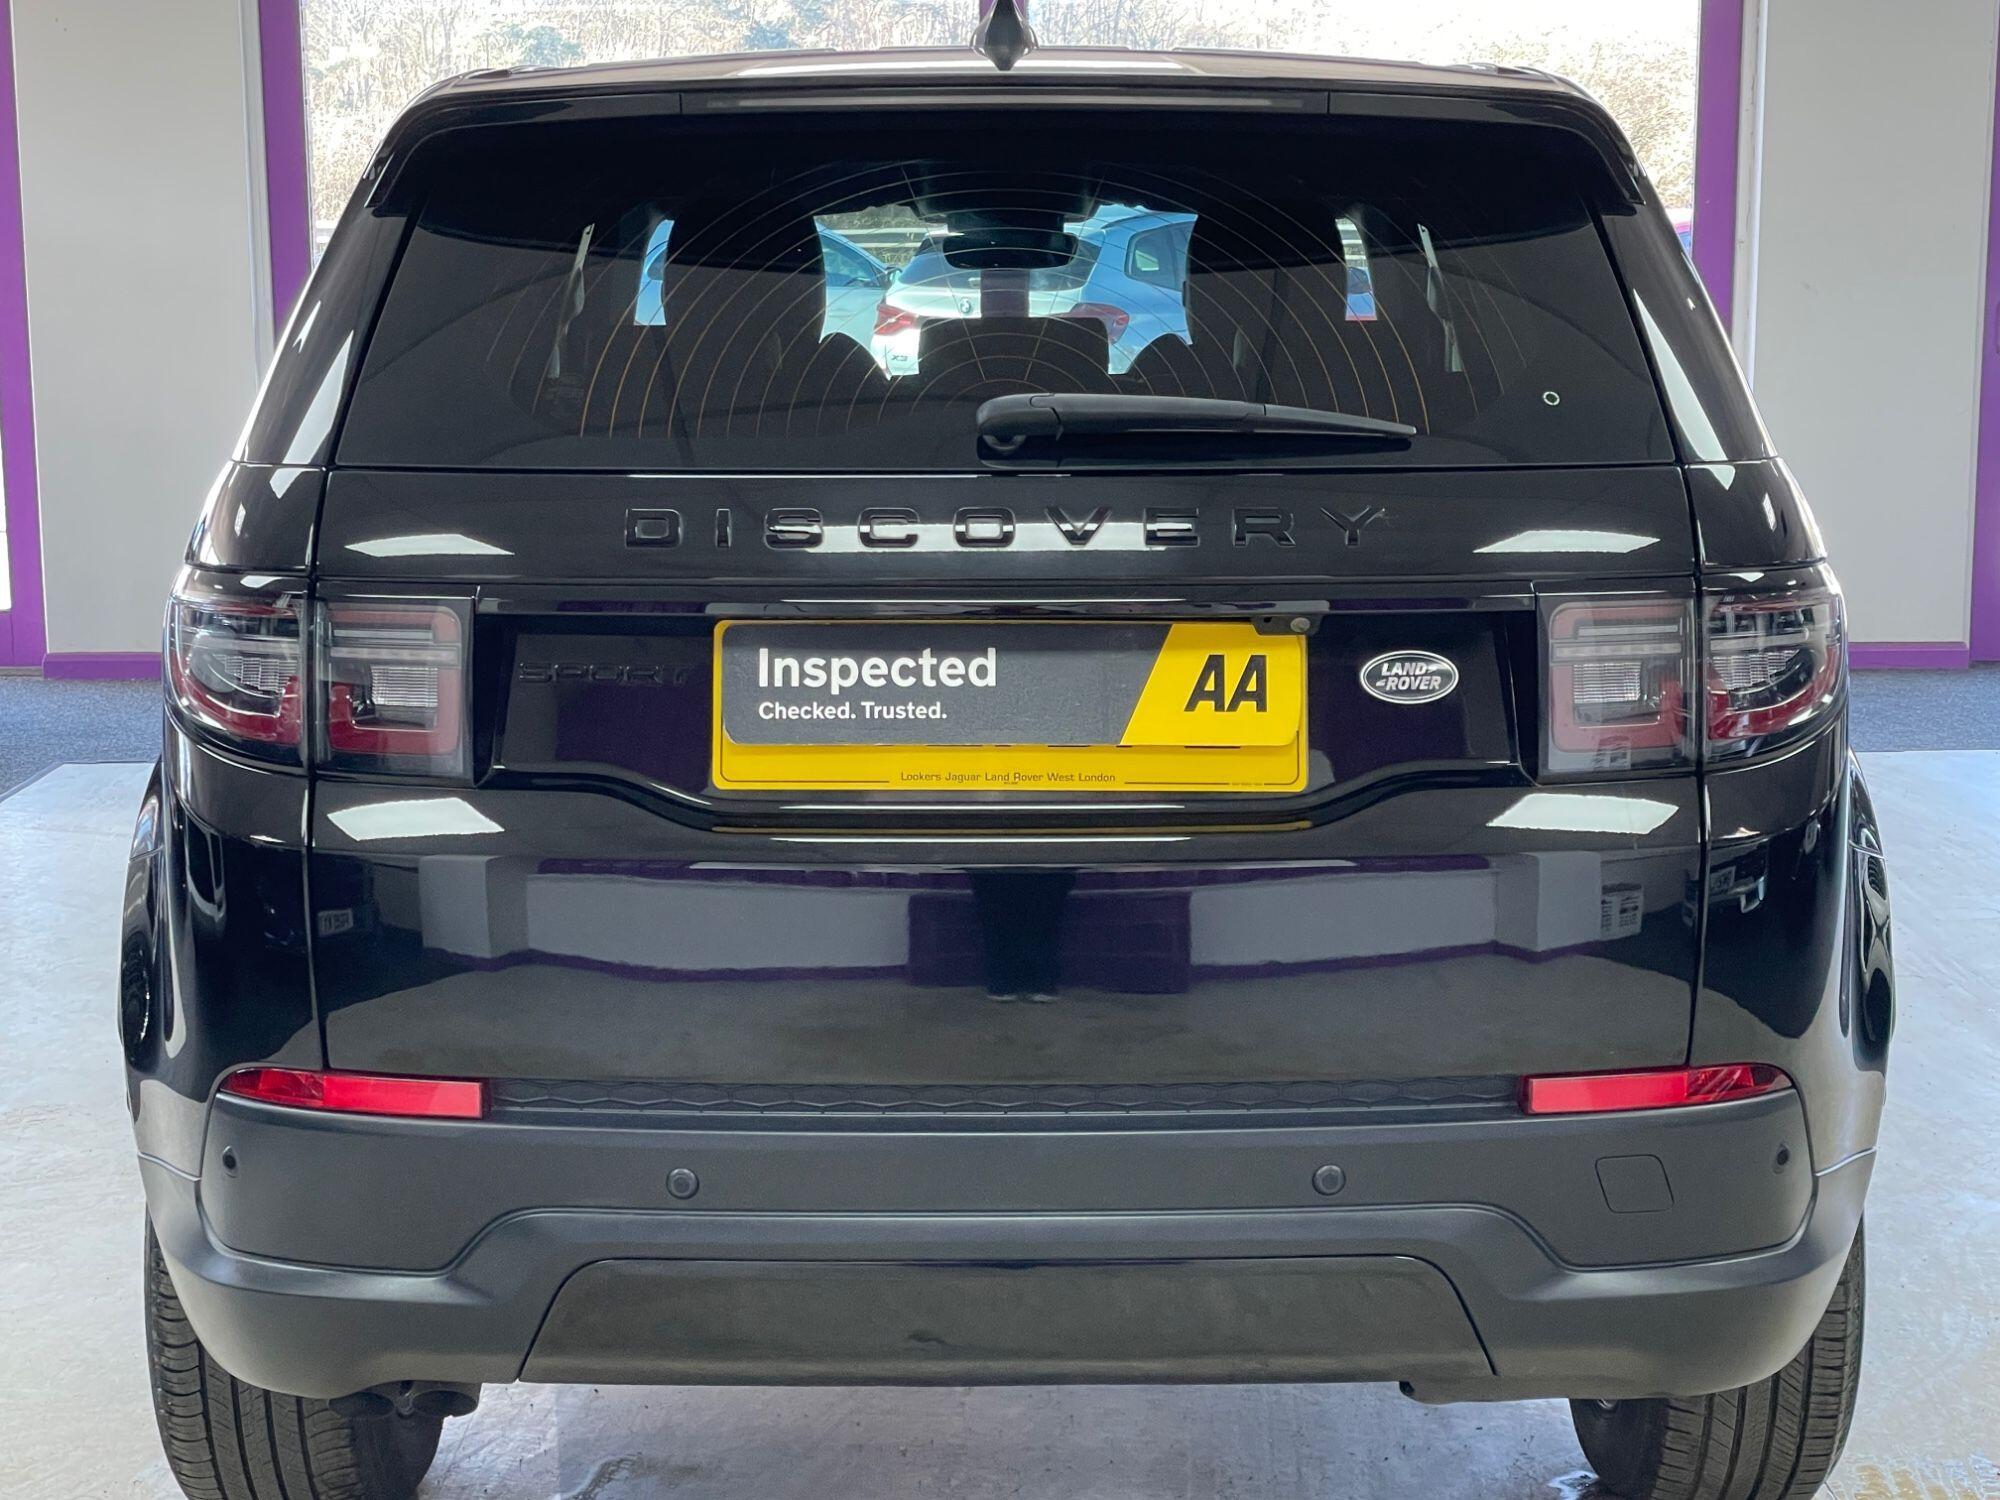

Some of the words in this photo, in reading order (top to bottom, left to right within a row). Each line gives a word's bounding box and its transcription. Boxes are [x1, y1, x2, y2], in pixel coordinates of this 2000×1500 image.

[624, 506, 1386, 550] DISCOVERY
[519, 663, 695, 685] SPORT
[758, 648, 997, 695] Inspected
[1382, 663, 1427, 676] LAND
[1184, 655, 1267, 712] AA
[1386, 676, 1441, 690] ROVER
[758, 702, 856, 719] Checked.
[861, 702, 947, 719] Trusted.
[901, 772, 941, 781] Lookers
[945, 773, 980, 783] Jaguar
[985, 773, 1009, 781] Land
[1014, 773, 1043, 781] Rover
[1047, 773, 1074, 781] West
[1079, 773, 1115, 782] London
